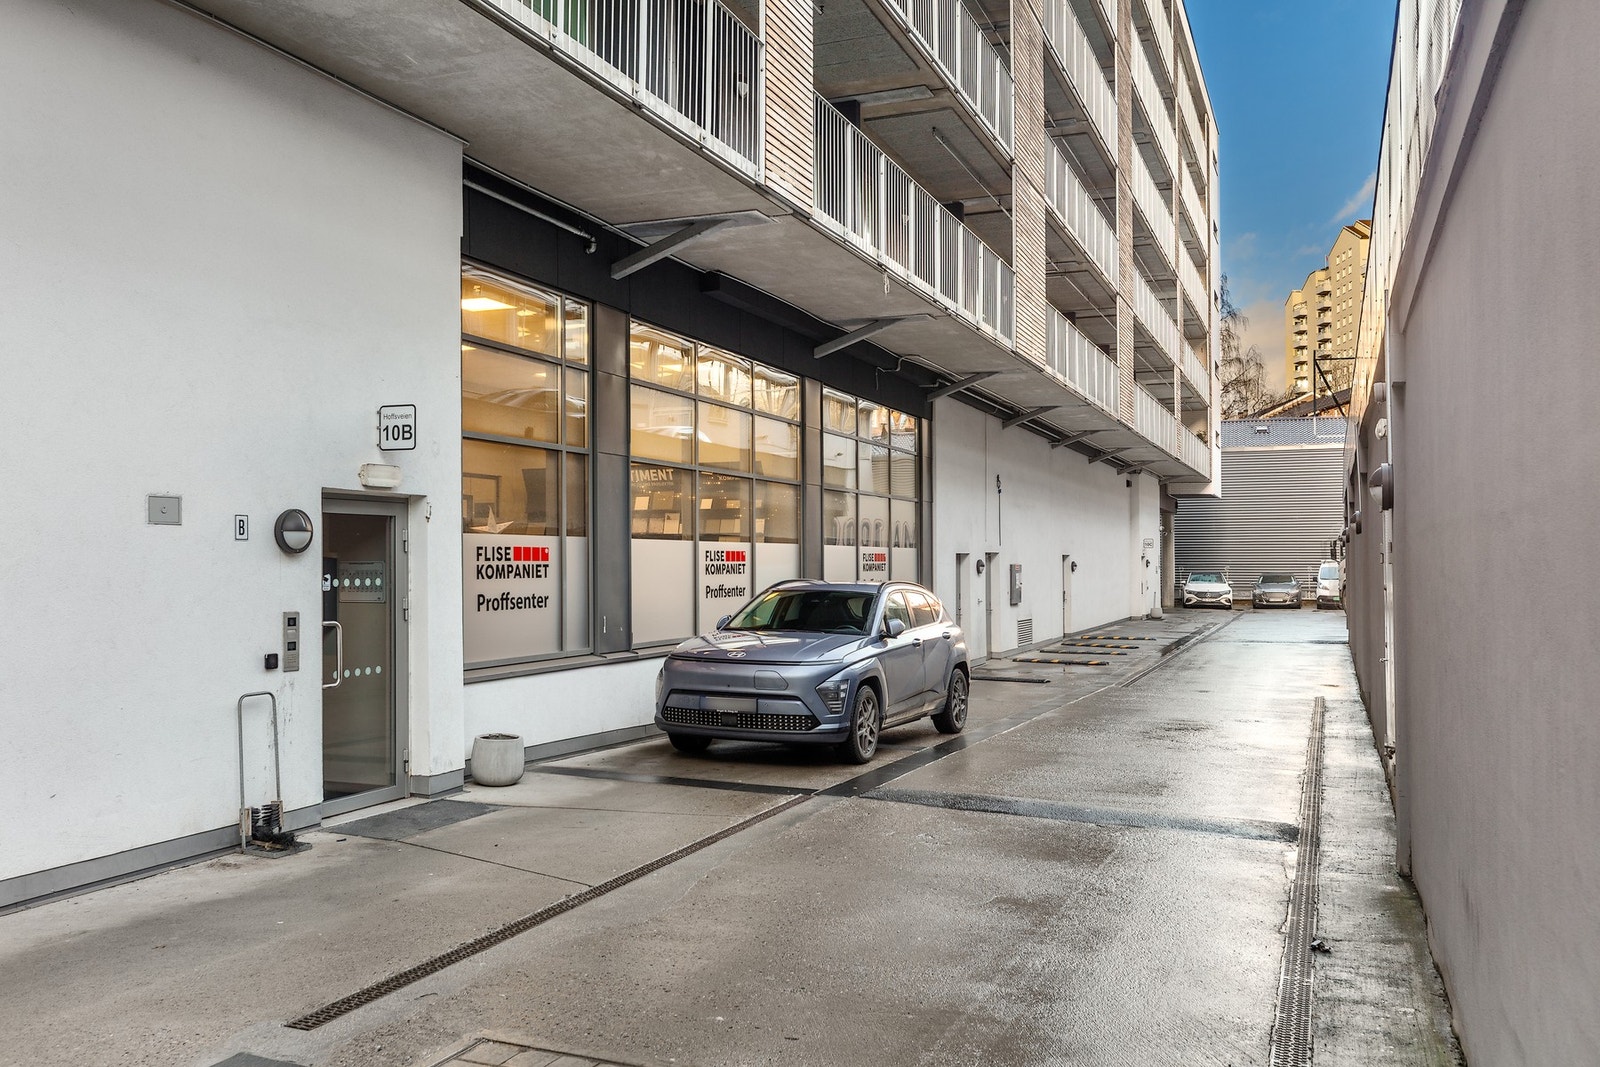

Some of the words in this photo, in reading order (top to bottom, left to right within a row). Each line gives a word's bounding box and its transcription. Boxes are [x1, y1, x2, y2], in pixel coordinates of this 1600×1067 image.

[383, 424, 413, 441] 10B
[238, 519, 245, 536] B
[476, 546, 511, 562] FLISE
[705, 550, 725, 562] FLISE
[476, 564, 549, 580] KOMPANIET
[705, 563, 746, 575] KOMPANIET
[705, 584, 746, 599] Proffsenter
[477, 591, 549, 612] Proffsenter
